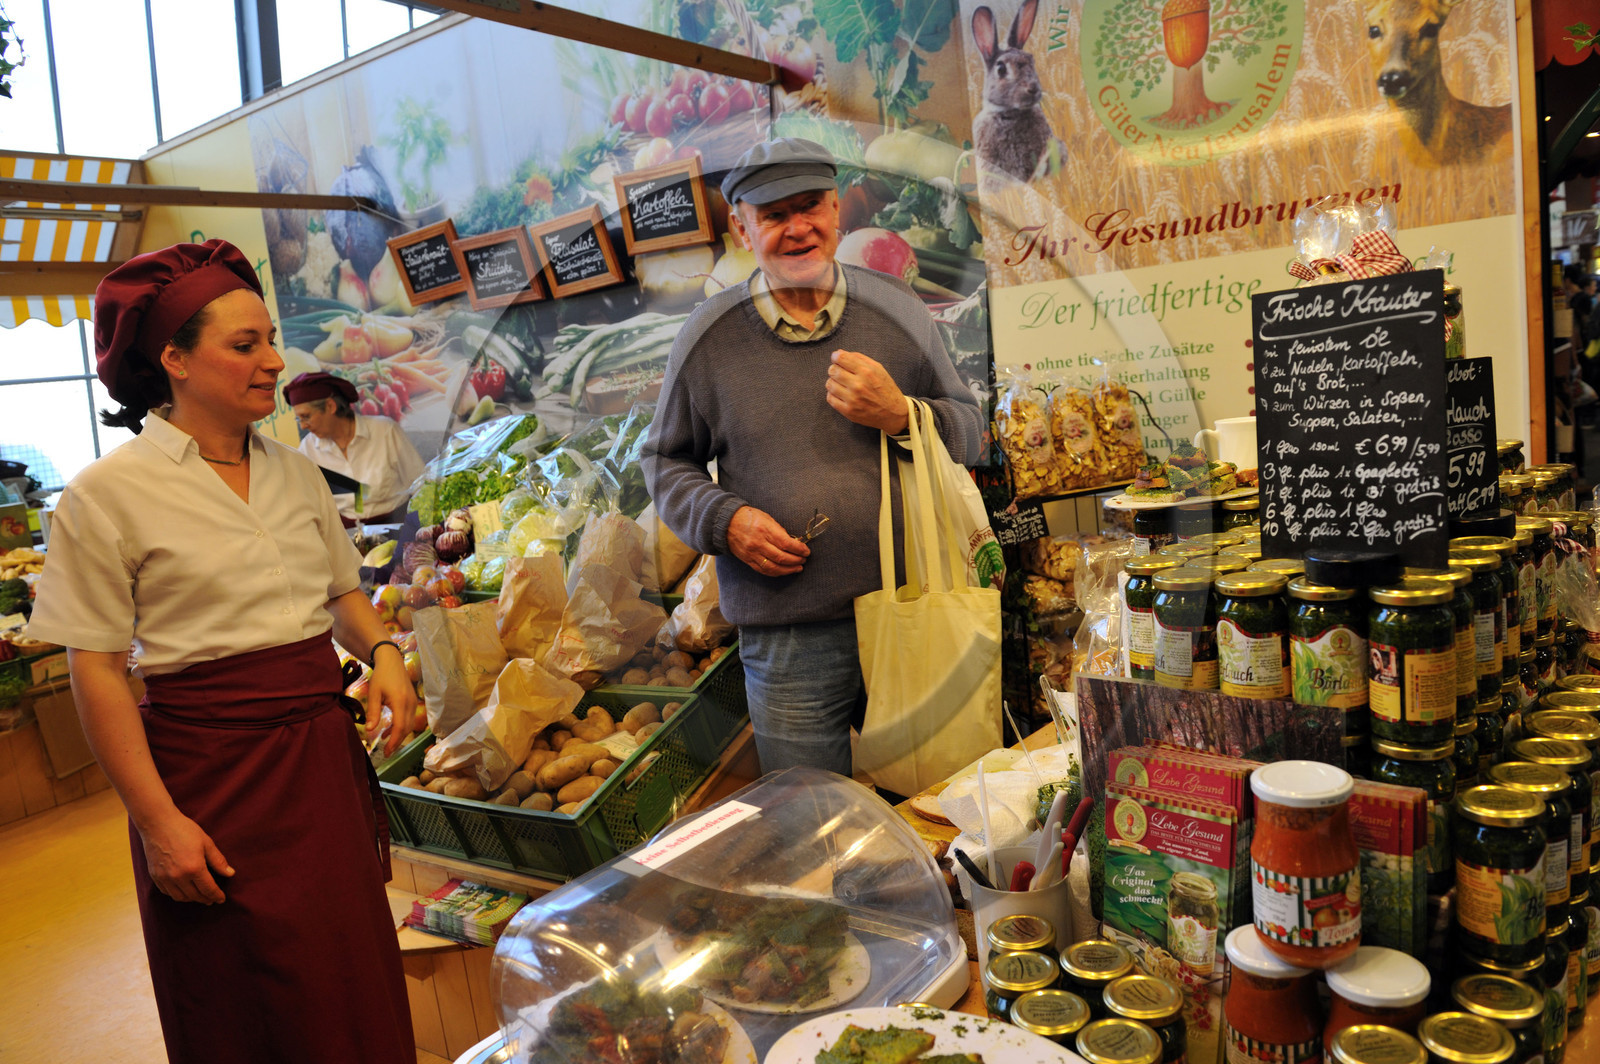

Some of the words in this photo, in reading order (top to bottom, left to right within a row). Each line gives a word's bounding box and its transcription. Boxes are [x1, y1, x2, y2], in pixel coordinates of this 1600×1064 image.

[1048, 5, 1071, 52] Wir
[1098, 84, 1149, 146] Güter
[632, 187, 689, 219] Kartoffeln
[1004, 224, 1077, 266] Ihr
[1018, 291, 1082, 332] Der
[1090, 274, 1262, 331] friedfertige
[1262, 292, 1335, 324] Frische
[1340, 284, 1432, 318] Kräuter
[1036, 356, 1073, 372] ohne
[1149, 341, 1215, 360] Zusätze
[1287, 336, 1351, 364] feinstem
[1270, 366, 1286, 378] zu
[1447, 361, 1482, 384] ebot:
[1159, 387, 1206, 404] Gülle
[1303, 395, 1351, 411] Würzen
[1359, 395, 1374, 409] in
[1446, 395, 1491, 424] rlauch
[1288, 412, 1340, 433] Suppen,
[1261, 439, 1271, 455] 1
[1354, 438, 1372, 456] €
[1262, 462, 1276, 480] 3
[1334, 465, 1351, 479] 1x
[1264, 484, 1275, 499] 4
[1339, 485, 1355, 499] 1x
[1394, 475, 1441, 505] gratis
[1265, 502, 1277, 520] 6
[1339, 501, 1351, 518] 1
[1262, 521, 1279, 537] 10
[1346, 523, 1360, 538] 2
[1151, 768, 1180, 788] Lebe
[1182, 773, 1225, 796] Gesund
[634, 847, 668, 866] Keine
[665, 807, 745, 850] Selbstbedienung
[1149, 811, 1179, 831] Lebe
[1180, 818, 1224, 843] Gesund
[1112, 874, 1156, 888] Original,
[1124, 864, 1146, 877] Das
[1119, 895, 1164, 906] schmeckt!
[1134, 887, 1151, 896] das
